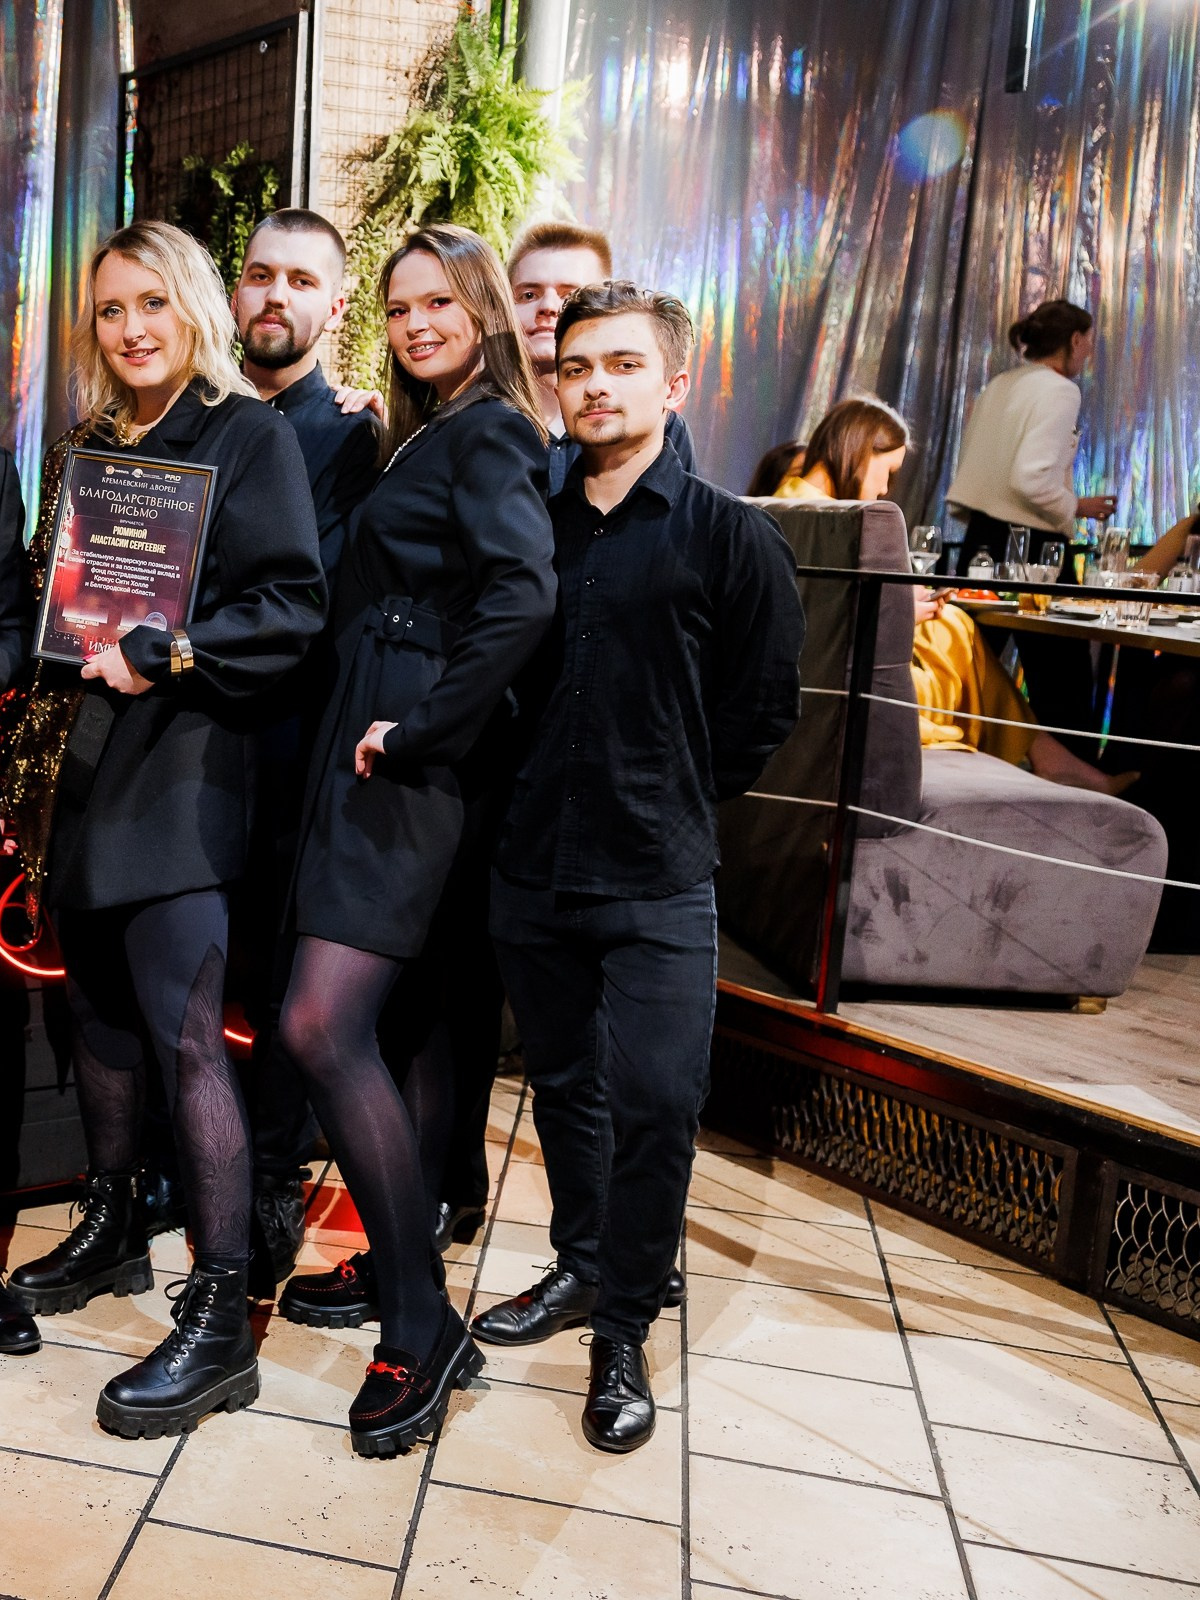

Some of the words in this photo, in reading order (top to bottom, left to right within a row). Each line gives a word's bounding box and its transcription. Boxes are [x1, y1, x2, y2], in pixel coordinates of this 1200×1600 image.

[102, 477, 148, 488] КРЕМЛЕВСКИЙ
[149, 484, 176, 493] ДВОРЕЦ
[79, 486, 195, 512] БЛАГОДАРСТВЕННОЕ
[110, 503, 158, 519] ПИСЬМО
[113, 526, 147, 539] РЮМИНОЙ
[90, 534, 129, 548] АНАСТАСИИ
[129, 540, 166, 554] СЕРГЕЕВНЕ
[80, 550, 114, 561] стабильную
[115, 556, 148, 567] лидерскую
[148, 562, 175, 571] позицию
[86, 559, 110, 568] отрасли
[124, 566, 156, 575] посильный
[91, 567, 106, 575] фонд
[90, 581, 130, 593] Белгородской
[131, 588, 156, 597] области
[94, 575, 114, 584] Крокус
[115, 577, 130, 586] Сити
[130, 580, 149, 589] Холле
